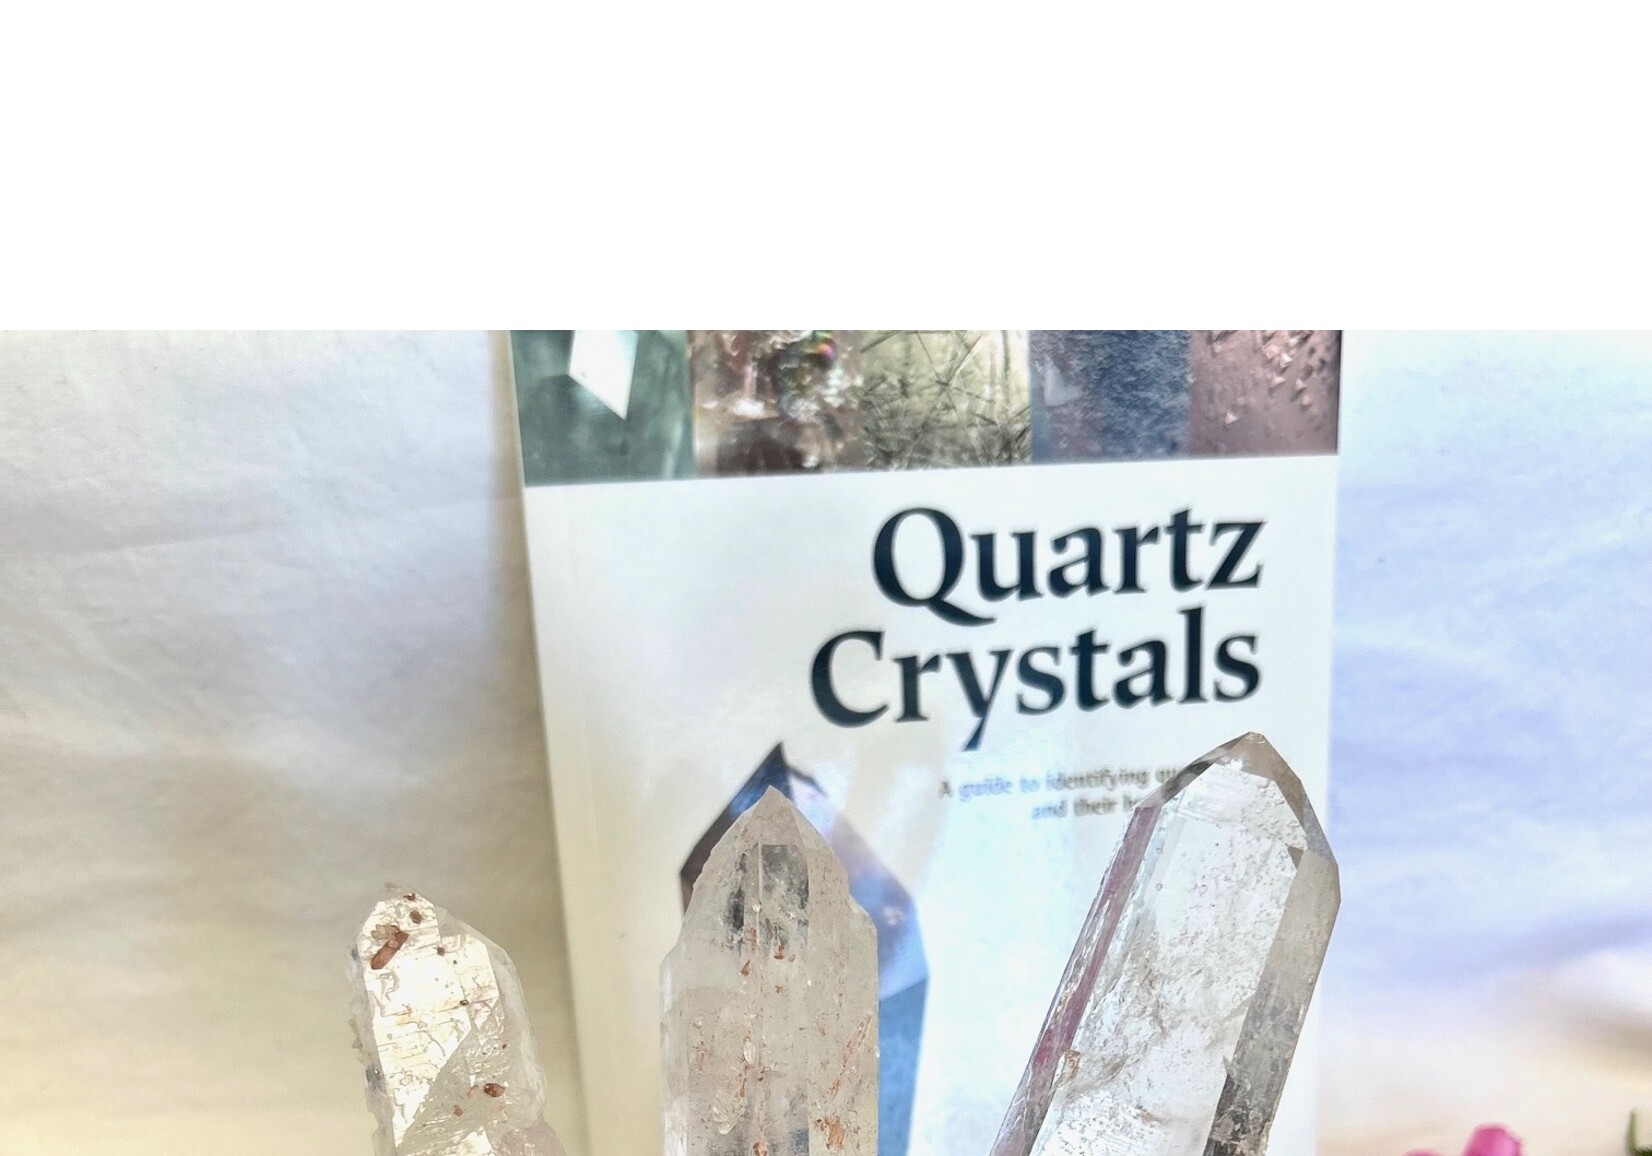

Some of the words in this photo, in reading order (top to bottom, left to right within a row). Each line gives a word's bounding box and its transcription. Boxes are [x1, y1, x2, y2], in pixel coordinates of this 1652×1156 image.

[873, 507, 1265, 626] Quartz
[810, 606, 1261, 751] Crystals
[938, 780, 953, 799] A
[959, 776, 1013, 802] guide
[1020, 777, 1040, 793] to
[1046, 766, 1149, 792] identifying
[1031, 800, 1066, 820] and
[1074, 796, 1117, 817] their
